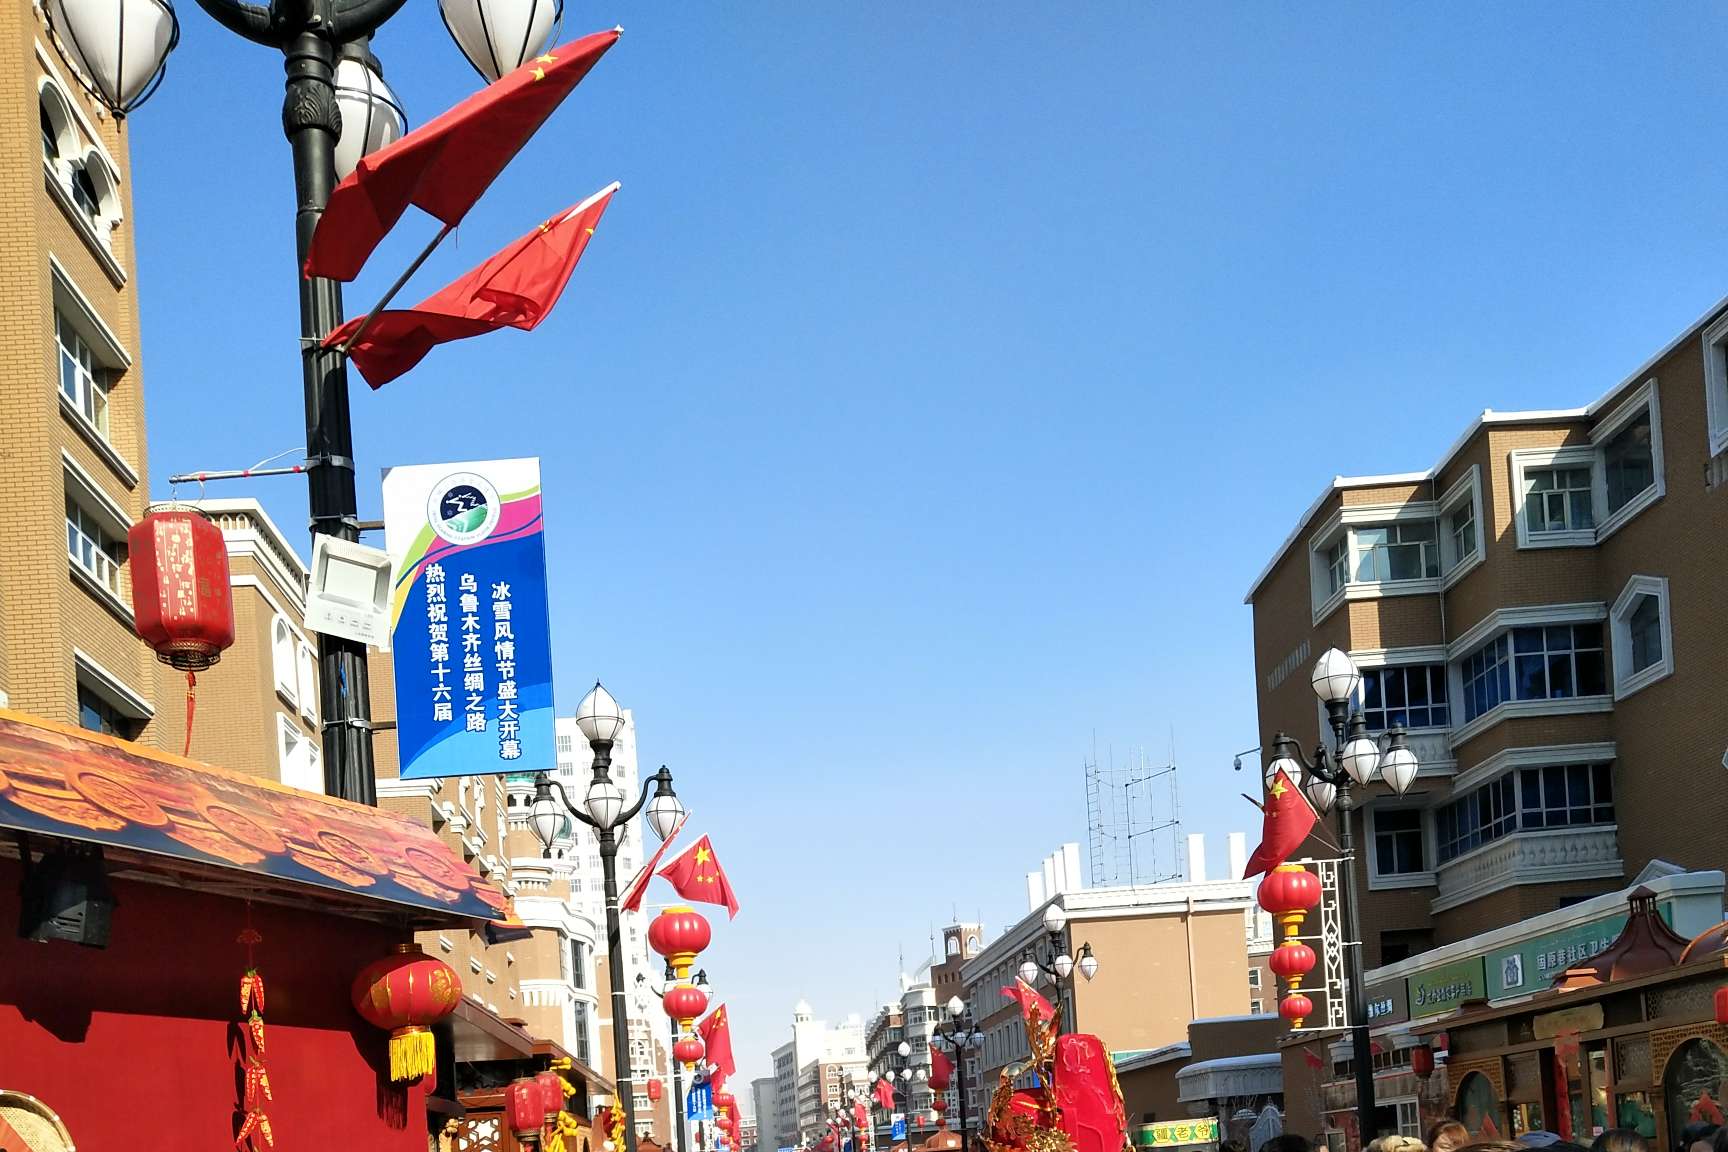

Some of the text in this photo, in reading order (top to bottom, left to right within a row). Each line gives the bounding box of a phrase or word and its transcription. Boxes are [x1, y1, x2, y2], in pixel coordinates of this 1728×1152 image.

[425, 563, 453, 722] 热烈祝贺第十六届
[458, 573, 487, 732] 乌鲁木齐丝绸之路
[491, 581, 521, 759] 冰雪风情节盛大开幕
